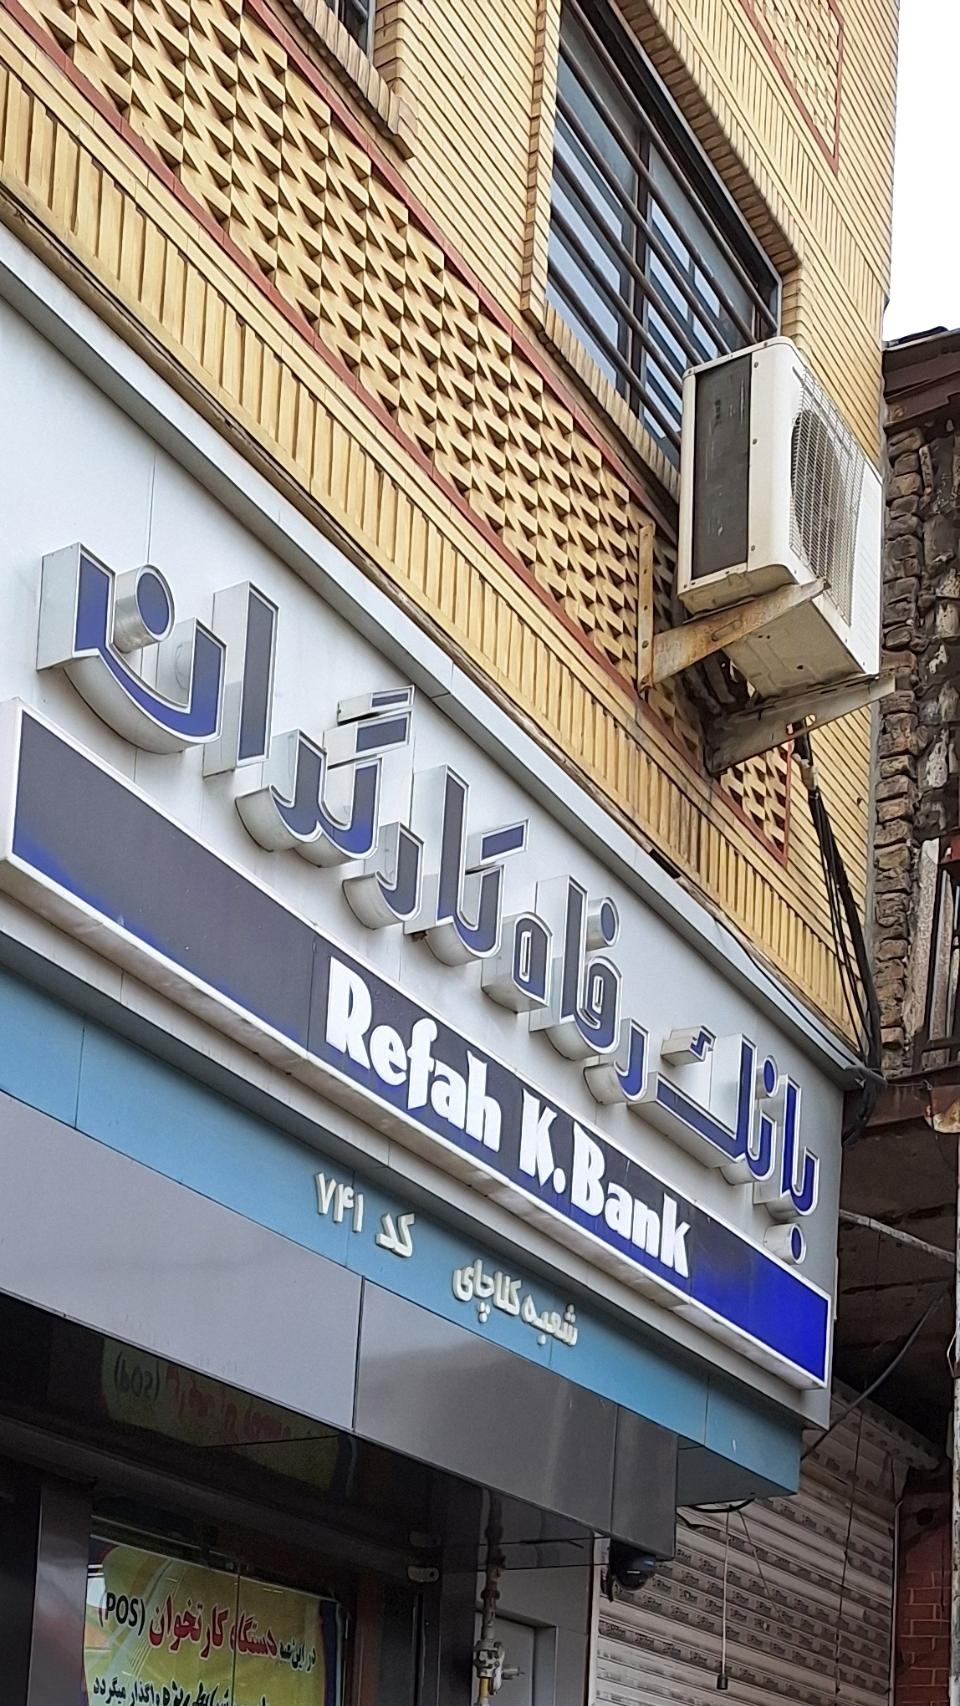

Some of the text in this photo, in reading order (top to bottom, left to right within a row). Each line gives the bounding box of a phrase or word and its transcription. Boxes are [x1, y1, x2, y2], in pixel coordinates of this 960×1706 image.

[38, 542, 820, 1265] بانک رفاه کارگران
[326, 957, 502, 1152] Refah
[314, 1171, 577, 1346] شعبه کلاچای کد ۷۴۱
[98, 1592, 145, 1636] (POS)
